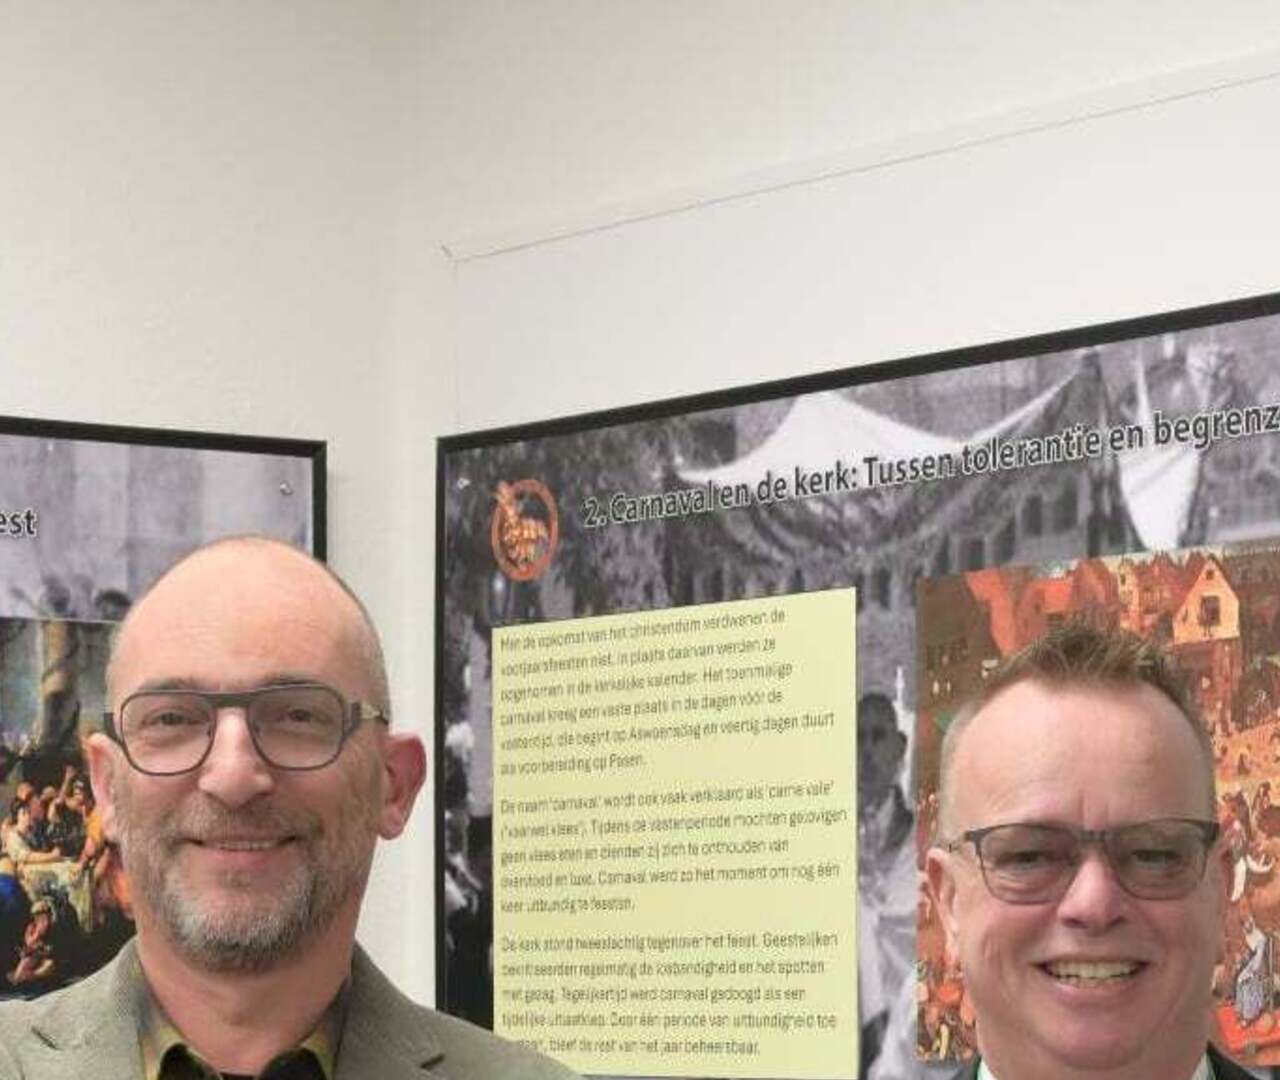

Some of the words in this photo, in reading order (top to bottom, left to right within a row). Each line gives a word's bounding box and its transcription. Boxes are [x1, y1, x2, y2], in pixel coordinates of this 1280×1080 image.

[583, 498, 608, 528] 2.
[610, 479, 715, 524] Carnaval
[719, 481, 750, 508] en
[757, 470, 786, 502] de
[794, 460, 858, 497] kerk:
[863, 453, 955, 488] Tussen
[961, 423, 1102, 474] tolerantie
[1108, 422, 1144, 451] en
